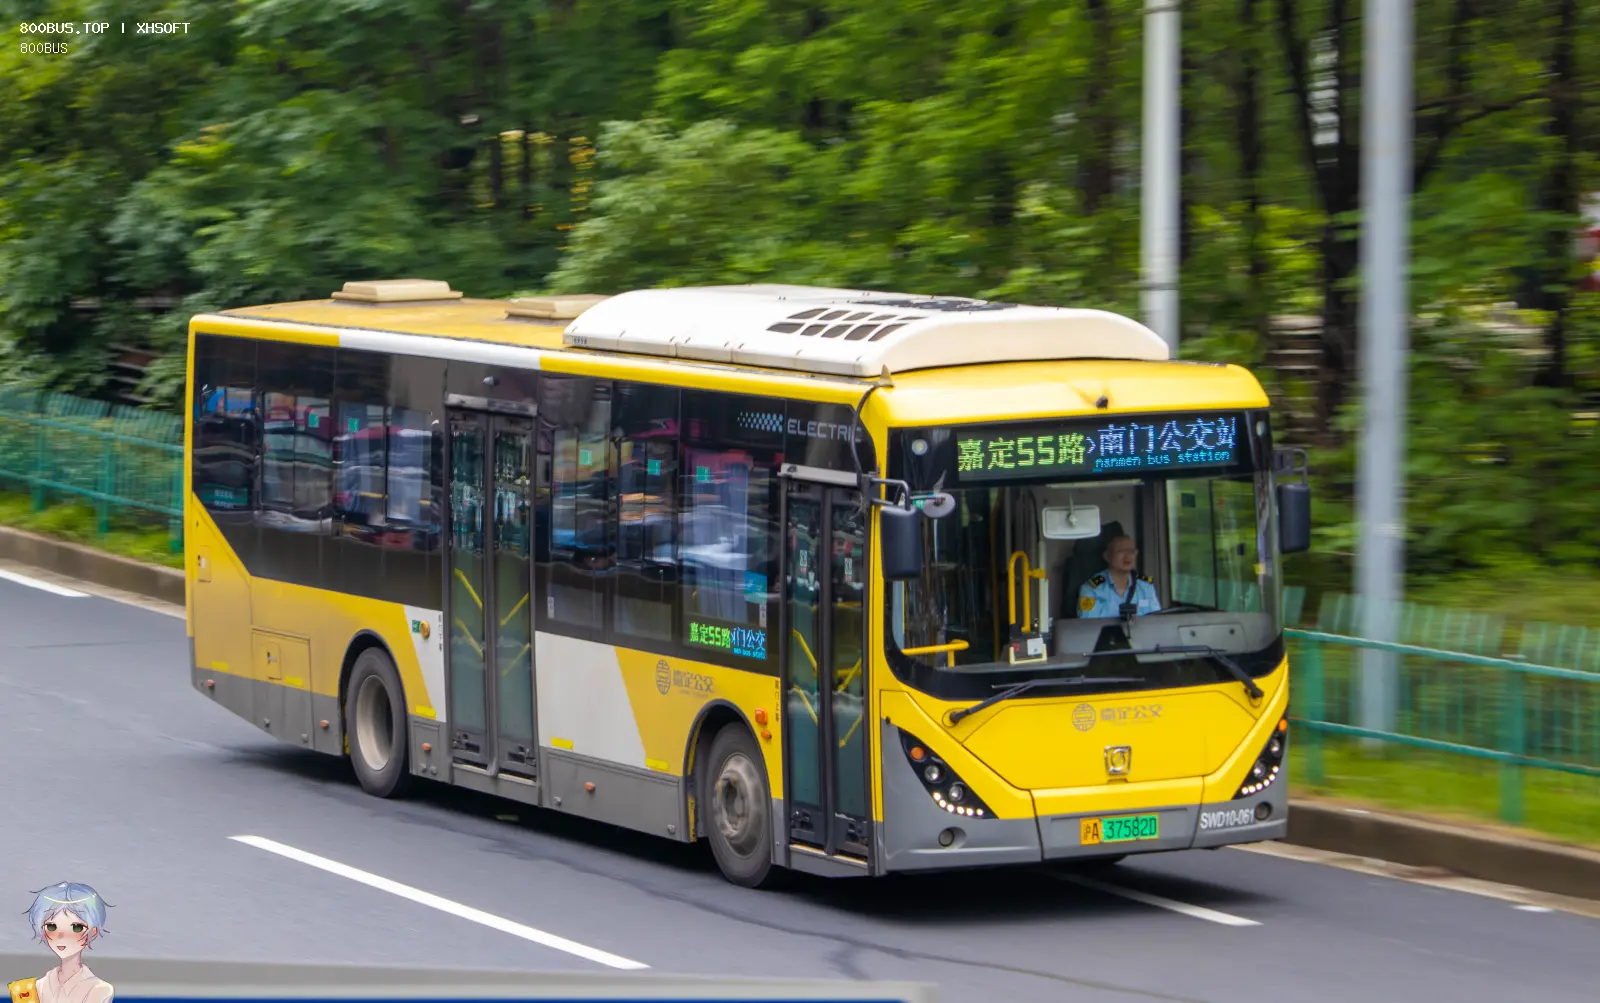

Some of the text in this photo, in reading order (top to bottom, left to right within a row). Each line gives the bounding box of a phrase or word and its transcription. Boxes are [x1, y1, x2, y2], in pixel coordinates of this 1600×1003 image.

[957, 432, 1086, 472] 嘉定55路
[1147, 453, 1171, 466] bus
[1177, 450, 1230, 464] station
[690, 622, 730, 648] 嘉定55路
[1106, 817, 1157, 839] 37582D
[1200, 808, 1255, 829] SWD10-061
